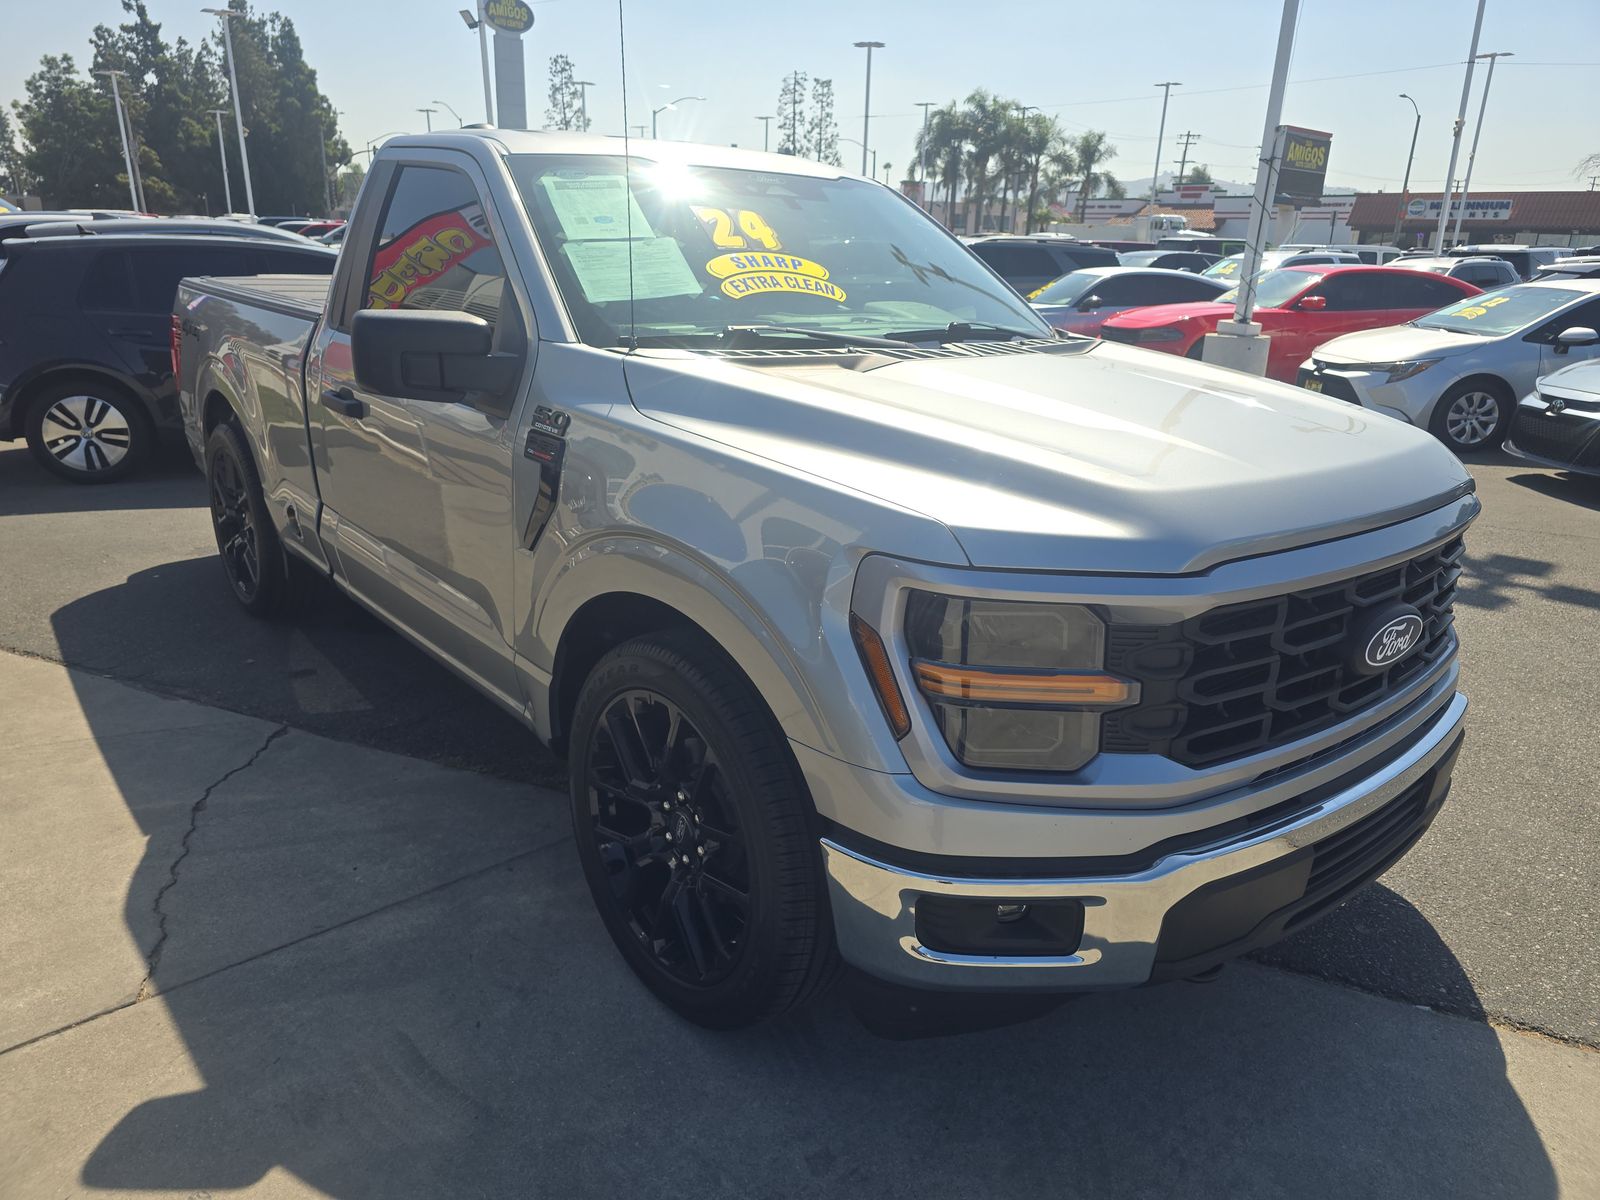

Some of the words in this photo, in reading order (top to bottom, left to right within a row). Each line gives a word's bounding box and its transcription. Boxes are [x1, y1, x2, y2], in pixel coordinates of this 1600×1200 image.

[488, 2, 528, 21] AMIGOS
[1287, 142, 1325, 166] AMIGOS
[1429, 201, 1511, 210] MILNNIUM
[698, 208, 780, 250] 24
[730, 255, 803, 270] SHARP
[729, 275, 783, 294] EXTRA
[784, 275, 836, 297] CLEAN
[532, 405, 571, 430] 5.0
[1376, 622, 1414, 660] Ford
